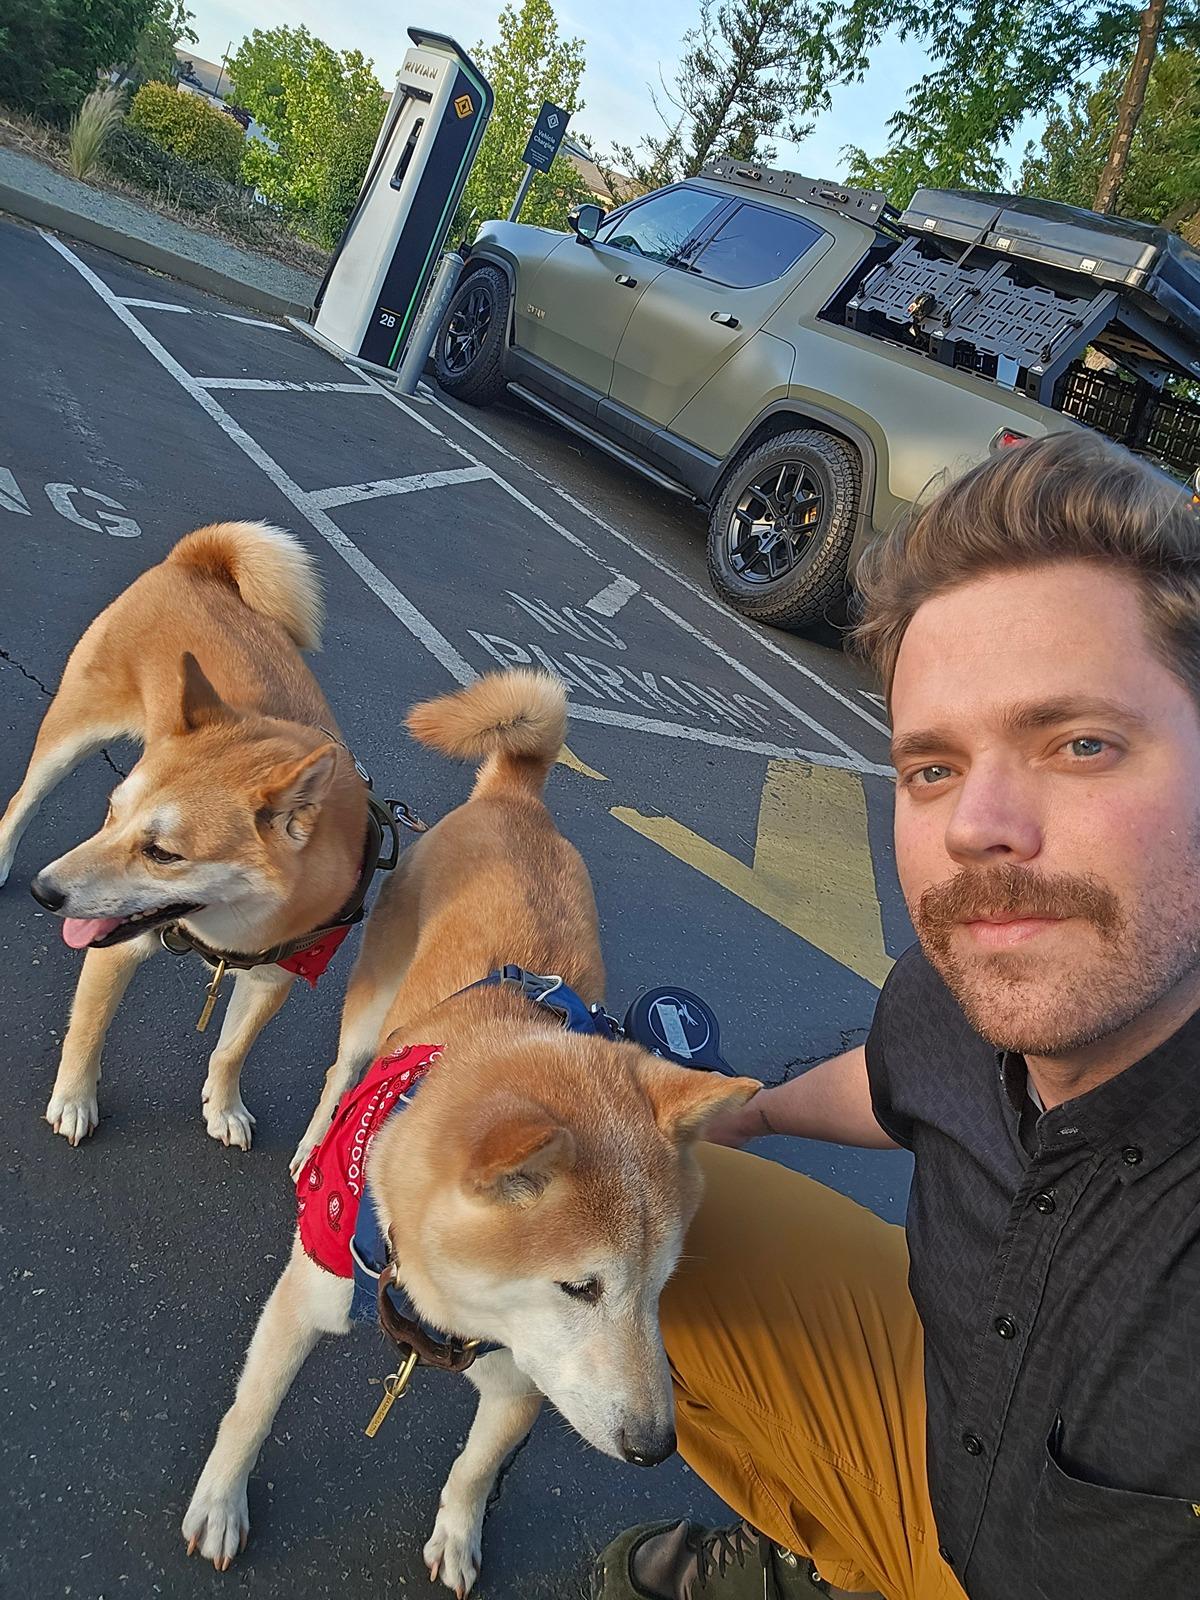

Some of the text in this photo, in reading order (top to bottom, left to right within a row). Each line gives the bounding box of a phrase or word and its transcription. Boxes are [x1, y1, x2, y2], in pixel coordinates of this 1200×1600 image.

[404, 61, 438, 80] RIVIAN
[379, 313, 396, 328] 2B
[504, 589, 628, 651] NO
[465, 628, 798, 740] PARKING
